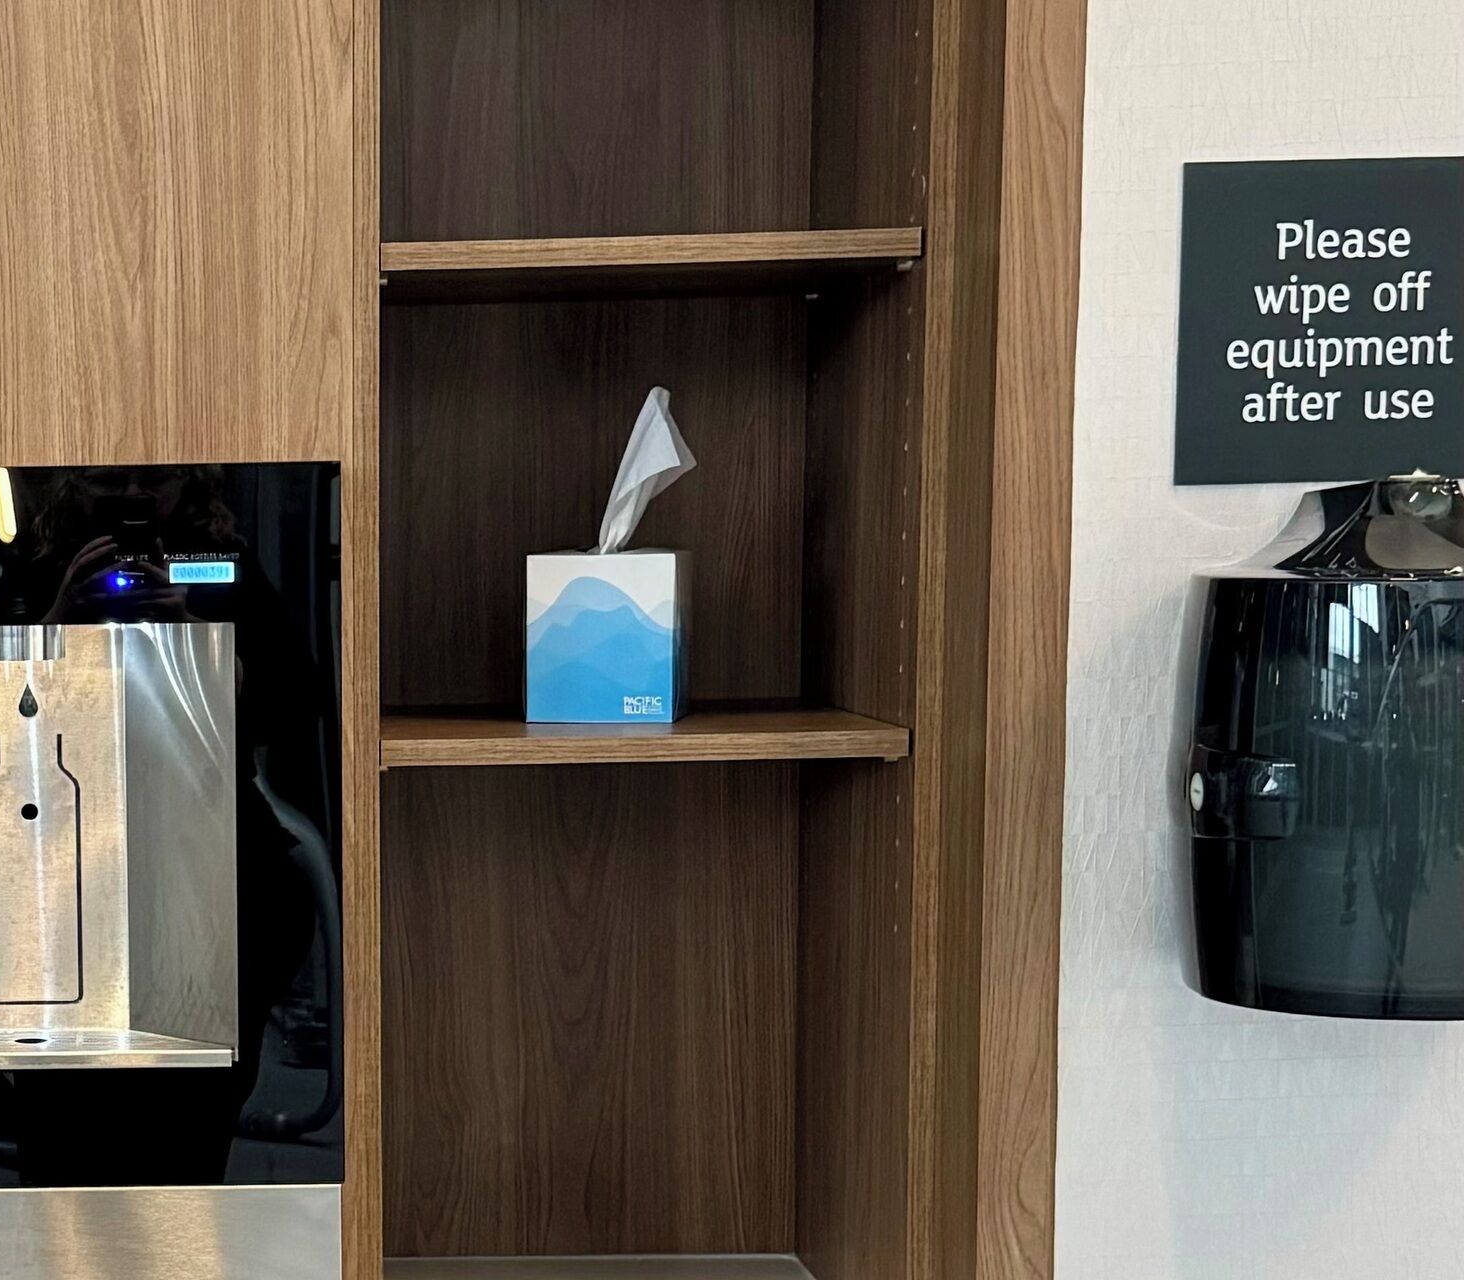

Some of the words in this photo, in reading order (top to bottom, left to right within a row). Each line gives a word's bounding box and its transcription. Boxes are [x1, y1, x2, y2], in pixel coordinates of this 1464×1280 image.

[1276, 219, 1412, 261] Please
[1254, 274, 1351, 325] wipe
[1372, 270, 1433, 312] off
[1225, 327, 1455, 379] equipment
[1241, 381, 1342, 423] after
[1363, 387, 1435, 420] use
[623, 696, 662, 706] PACIFIC
[623, 705, 647, 714] BLUE
